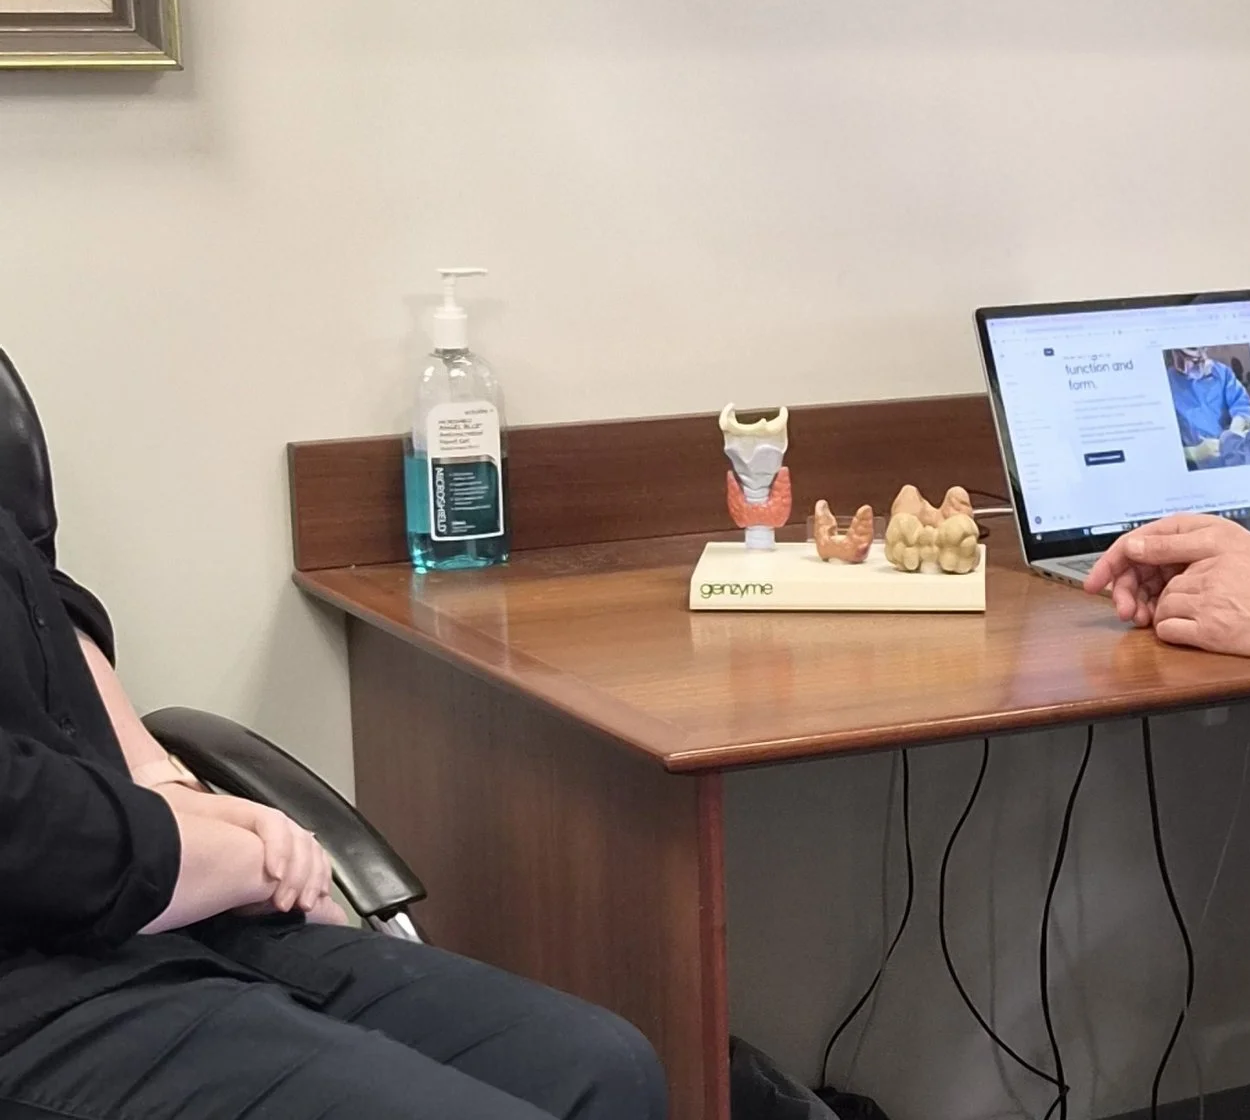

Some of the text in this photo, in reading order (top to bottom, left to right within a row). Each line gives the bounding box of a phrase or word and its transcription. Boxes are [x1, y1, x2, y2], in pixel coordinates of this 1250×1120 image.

[1065, 359, 1134, 376] function and
[435, 467, 447, 533] MICROSHIELD
[700, 581, 773, 599] genzyme
